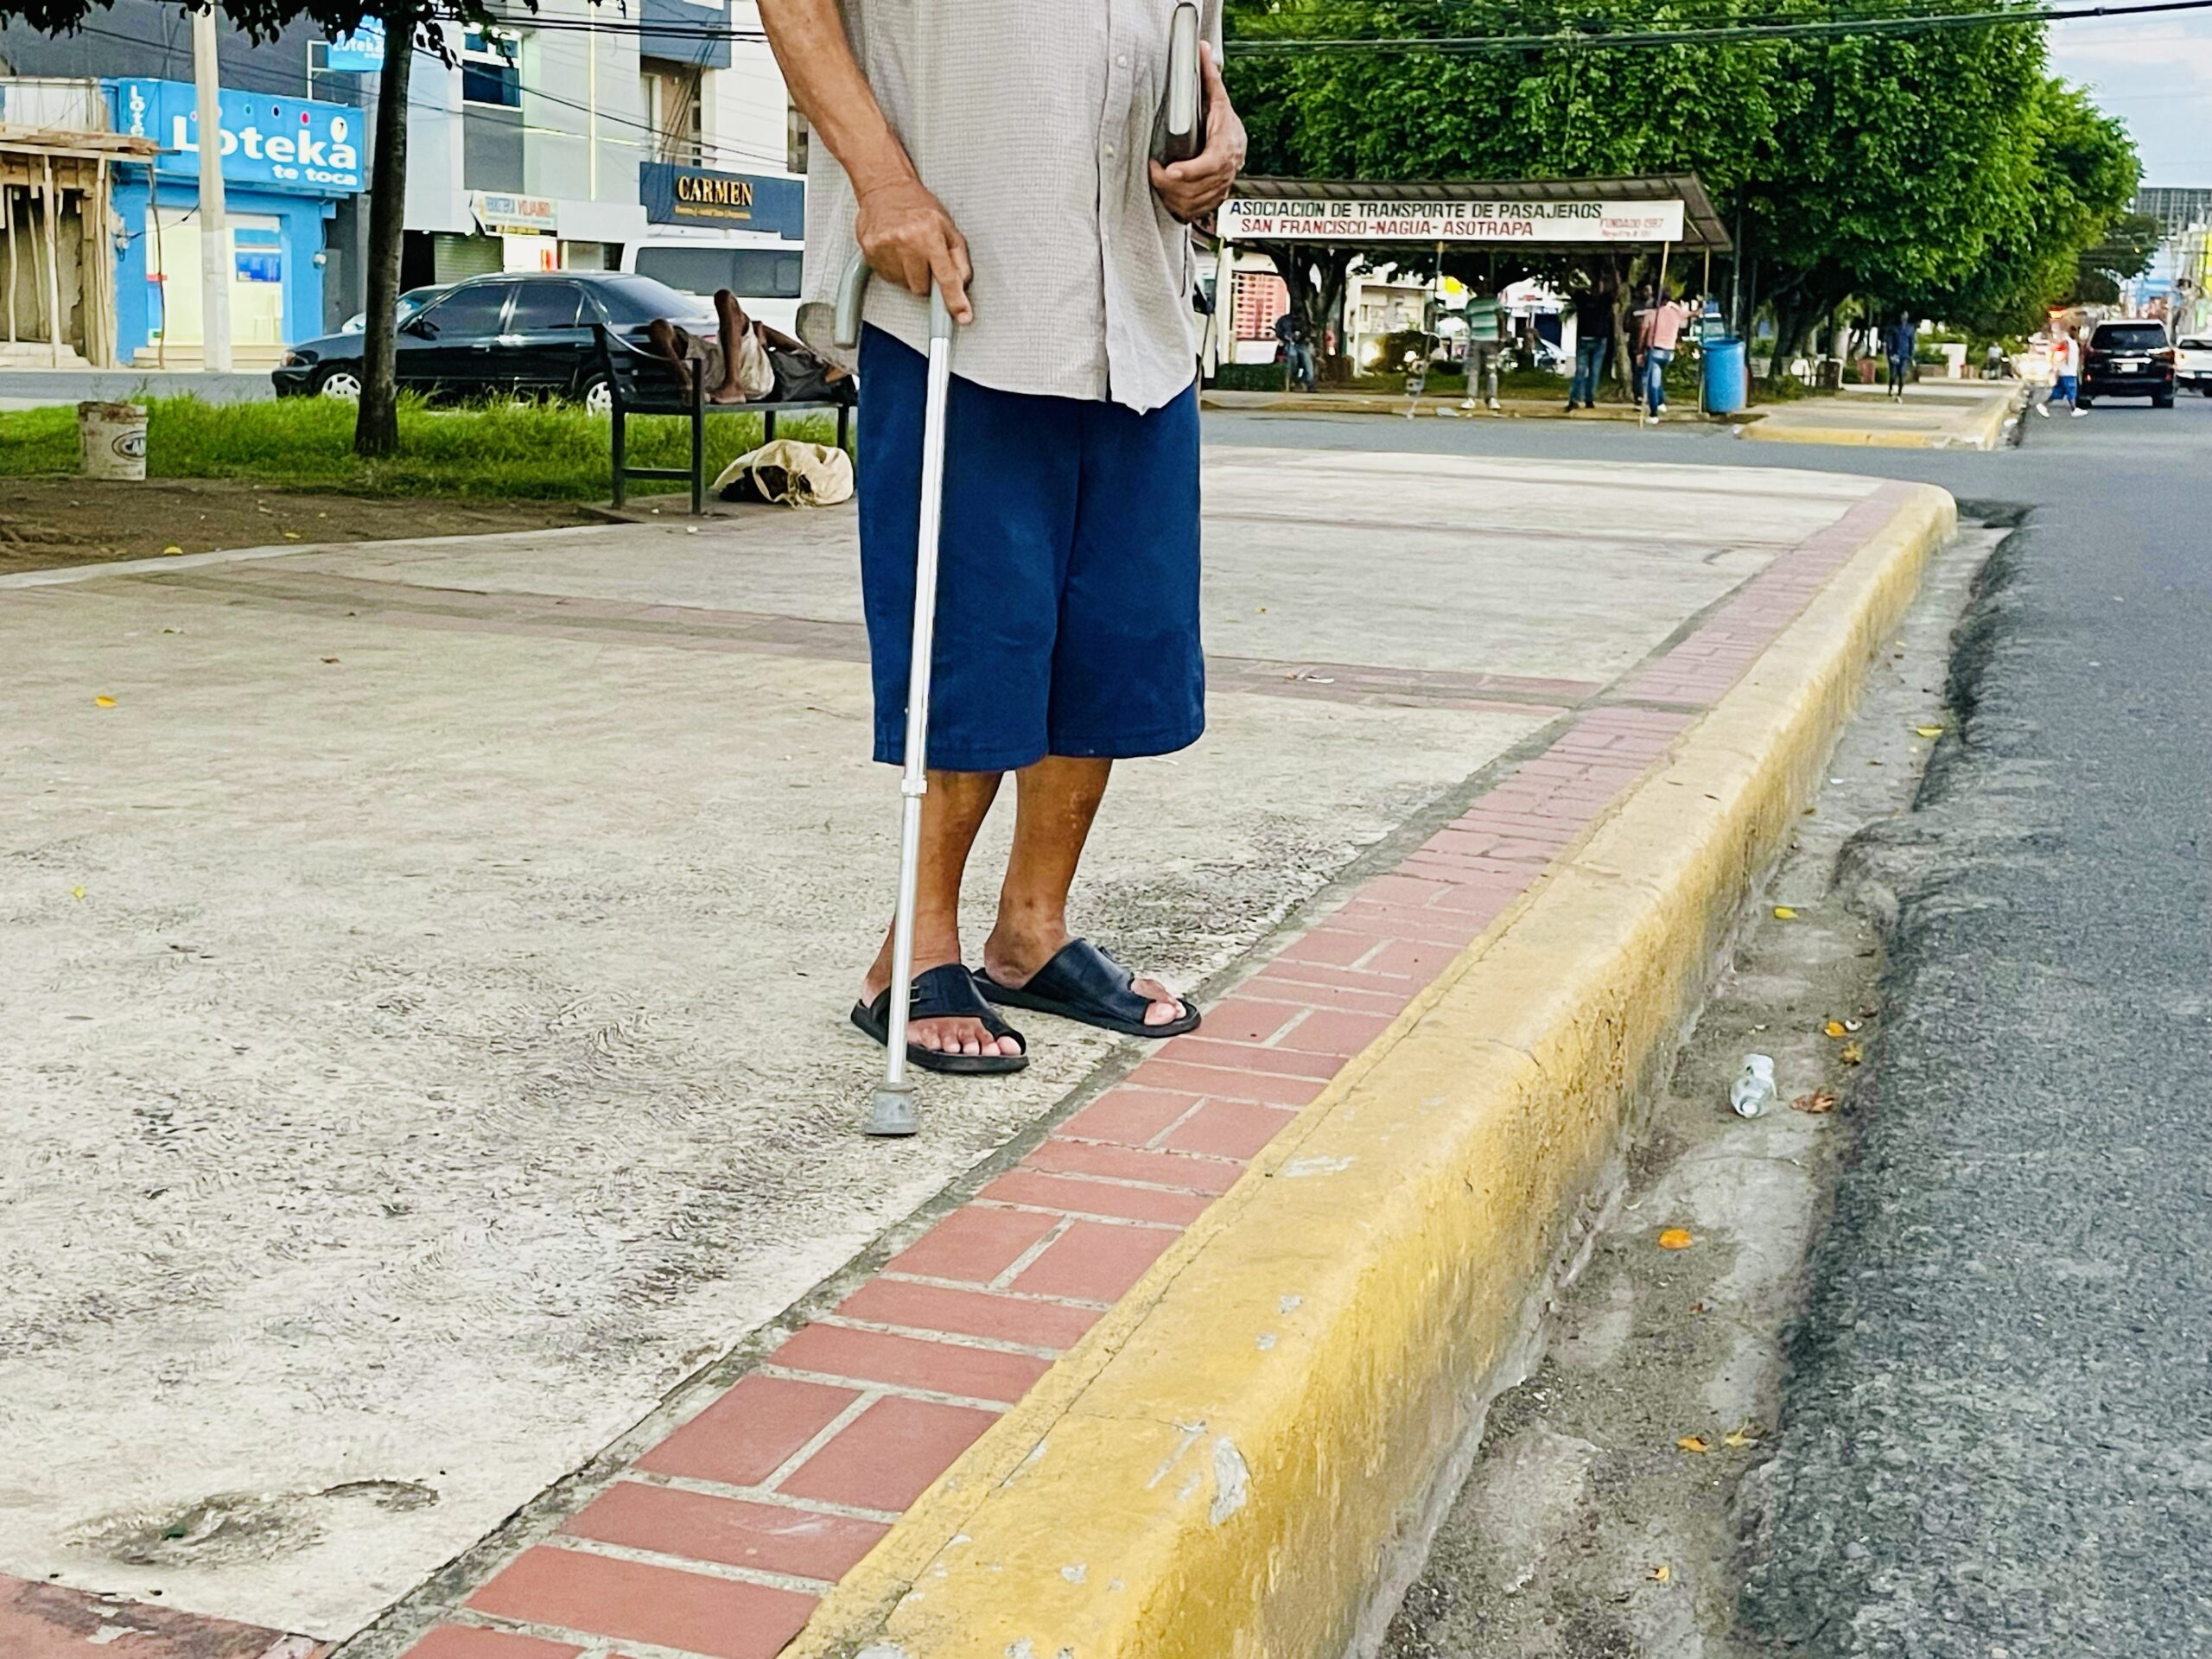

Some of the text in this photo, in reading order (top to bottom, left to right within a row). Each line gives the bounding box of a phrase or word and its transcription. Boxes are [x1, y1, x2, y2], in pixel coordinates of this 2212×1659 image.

[272, 164, 358, 186] te toca
[678, 175, 753, 207] CARMEN
[1332, 203, 1351, 217] DE
[1359, 203, 1465, 218] TRANSPORTE
[1472, 204, 1493, 218] DE
[1499, 204, 1603, 219] PASAJEROS
[1242, 219, 1272, 232] SAN
[1443, 221, 1533, 236] ASOTRAPA
